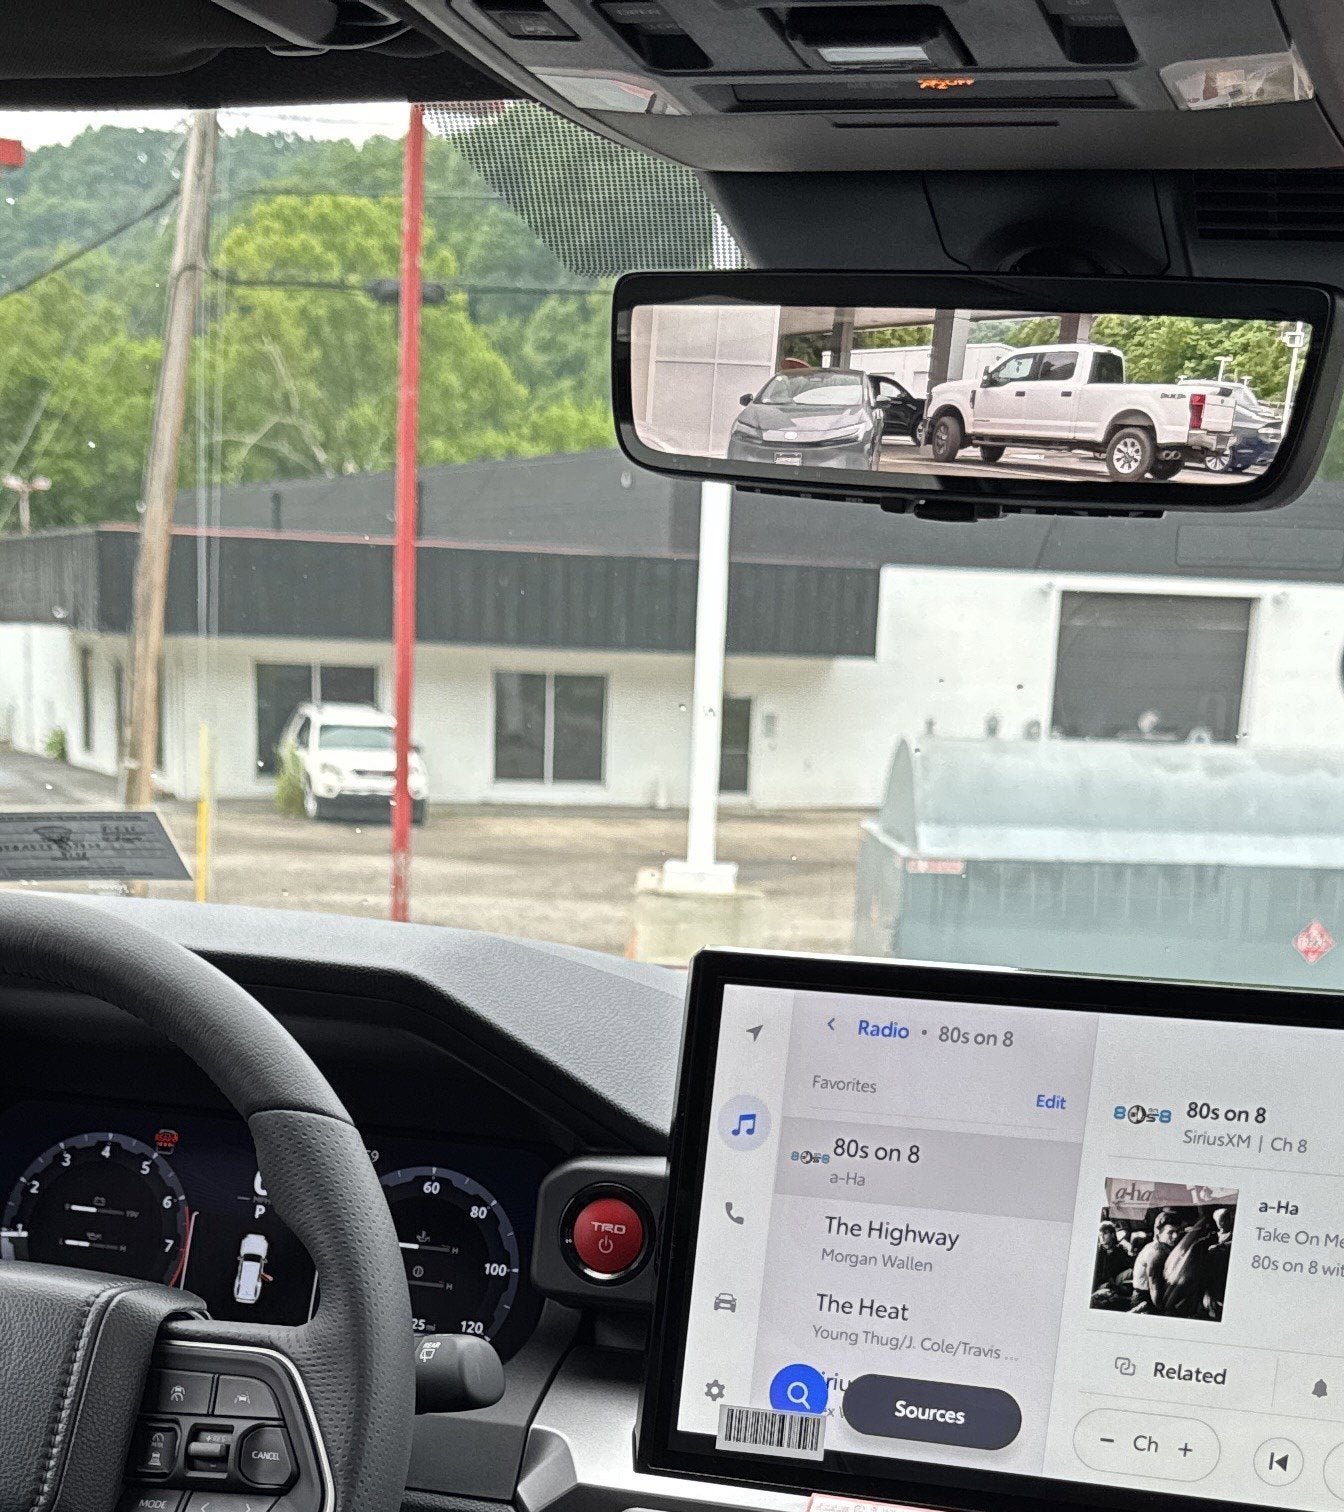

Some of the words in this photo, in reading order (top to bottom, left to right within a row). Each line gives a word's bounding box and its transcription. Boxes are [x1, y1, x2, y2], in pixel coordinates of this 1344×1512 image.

[858, 1020, 910, 1039] Radio
[938, 1026, 970, 1045] 80s
[974, 1032, 998, 1046] on
[1002, 1031, 1014, 1047] 8
[812, 1074, 877, 1094] Favorites
[1035, 1094, 1067, 1110] Edit
[1186, 1102, 1221, 1122] 80s
[1224, 1108, 1250, 1123] on
[1254, 1107, 1267, 1124] 8
[833, 1138, 870, 1159] 80s
[875, 1146, 902, 1162] on
[907, 1145, 921, 1163] 8
[1183, 1130, 1252, 1150] SiriusXM
[1271, 1137, 1295, 1153] Ch
[1297, 1139, 1308, 1154] 8
[101, 1145, 112, 1159] 4
[61, 1154, 72, 1168] 3
[140, 1161, 151, 1175] 5
[29, 1180, 40, 1194] 2
[423, 1181, 441, 1195] 60
[828, 1172, 867, 1188] a-Ha
[162, 1196, 173, 1209] 6
[1115, 1185, 1153, 1203] a-ha
[470, 1205, 488, 1220] 80
[1258, 1199, 1300, 1216] a-Ha
[591, 1220, 627, 1235] TRD
[825, 1215, 863, 1237] The
[867, 1220, 960, 1251] Highway
[164, 1239, 175, 1253] 7
[1256, 1227, 1291, 1246] Take
[1294, 1230, 1320, 1248] On
[821, 1248, 878, 1268] Morgan
[882, 1253, 934, 1272] Wallen
[1251, 1254, 1279, 1272] 80s
[1282, 1261, 1304, 1275] on
[1308, 1260, 1319, 1276] 8
[484, 1263, 507, 1277] 100
[816, 1293, 854, 1315] The
[859, 1298, 910, 1322] Heat
[460, 1320, 484, 1333] 120
[423, 1341, 441, 1349] REAR
[812, 1325, 859, 1346] Young
[863, 1331, 917, 1351] Thug/J.
[920, 1337, 1002, 1360] Cole/Travis
[1153, 1361, 1228, 1386] Related
[894, 1400, 966, 1425] Sources
[1132, 1434, 1159, 1454] Ch
[137, 1499, 167, 1510] MODE
